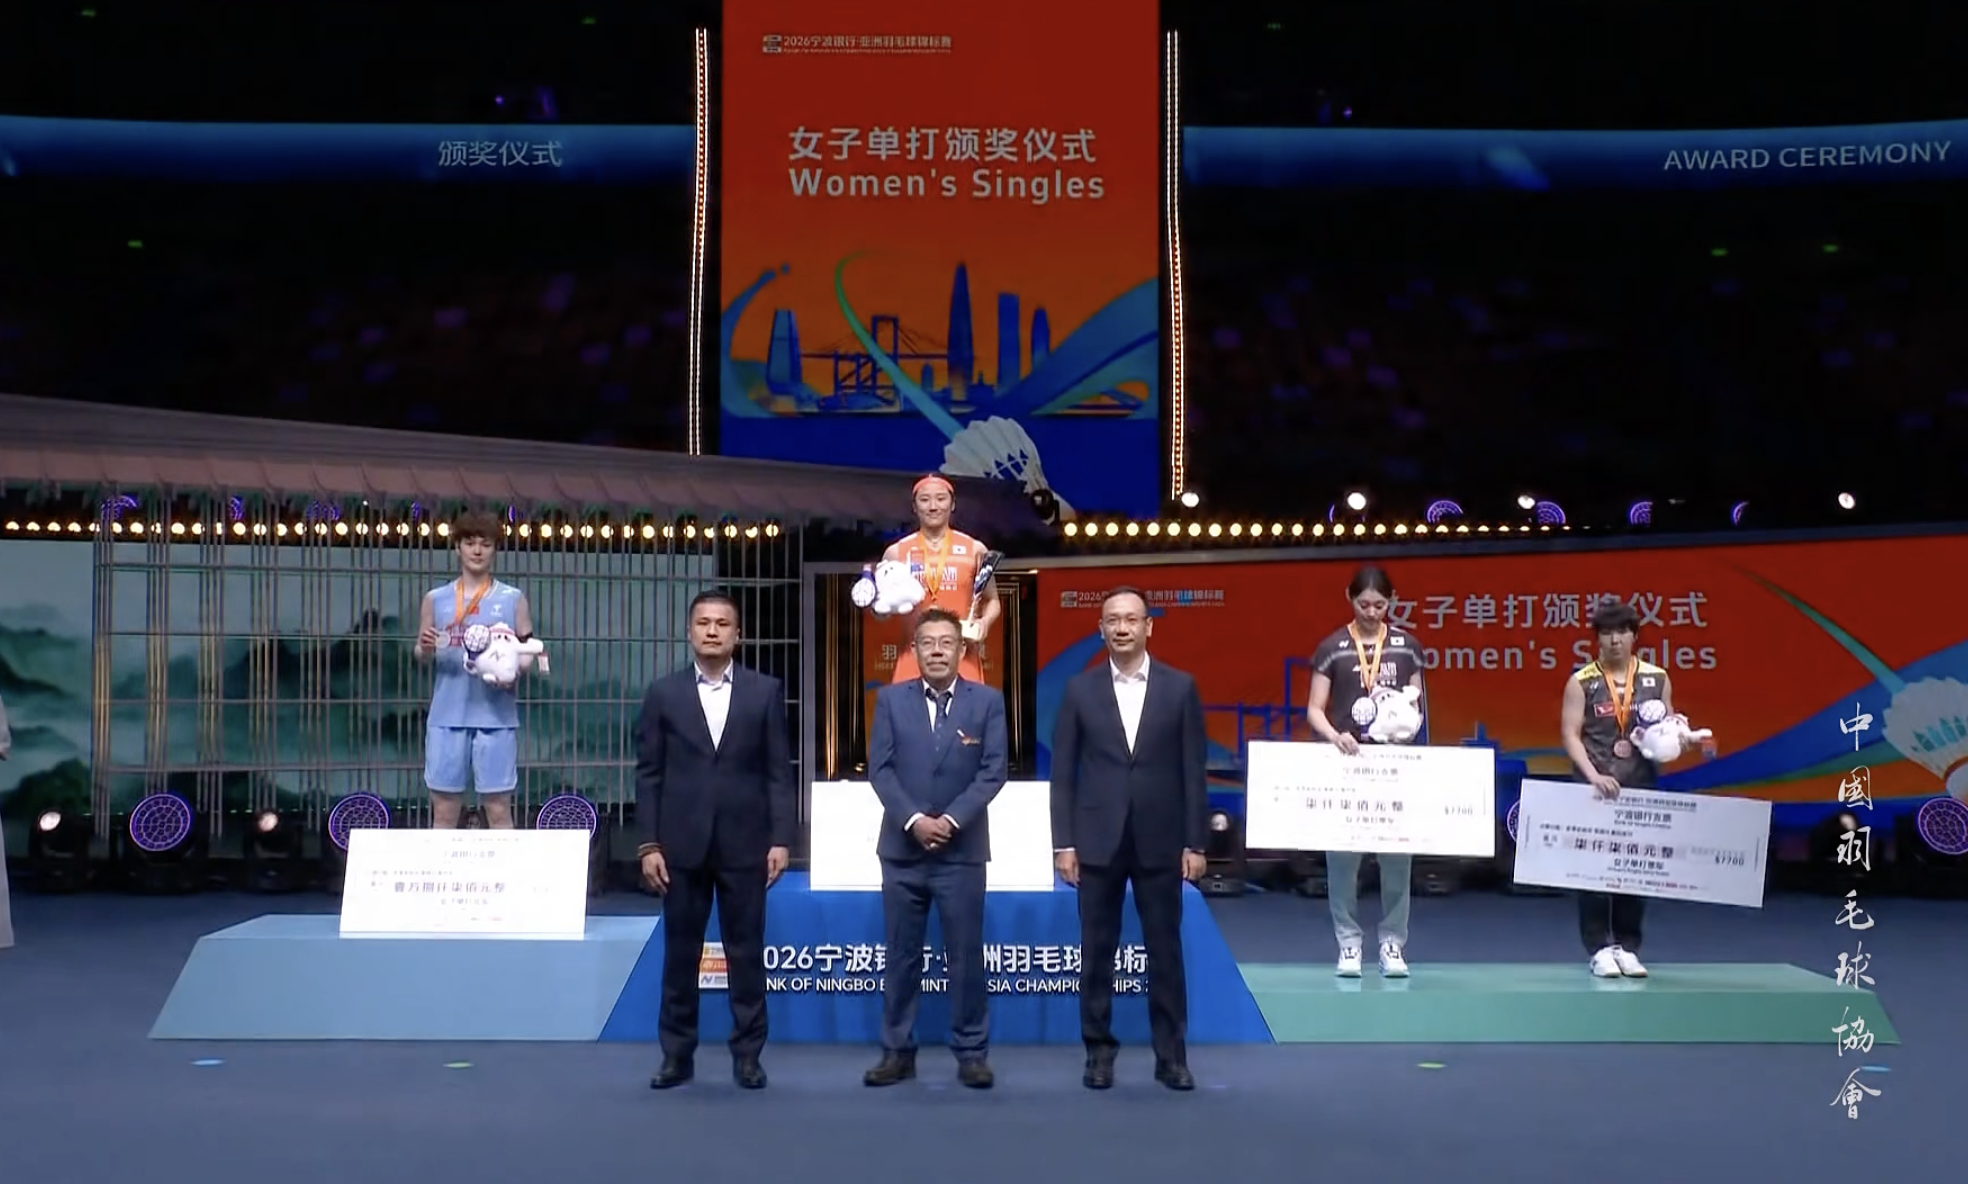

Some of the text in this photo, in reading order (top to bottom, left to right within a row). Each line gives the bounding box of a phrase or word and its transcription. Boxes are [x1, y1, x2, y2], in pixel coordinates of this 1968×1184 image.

[438, 140, 563, 167] 颁奖仪式
[788, 126, 1097, 162] 女子单打颁奖仪式
[1663, 140, 1951, 171] AWARD CEREMONY
[788, 167, 1105, 205] Women's Singles
[1423, 640, 1558, 670] omen's
[1714, 855, 1745, 867] $7700
[766, 977, 787, 992] NK
[790, 977, 813, 992] OF
[816, 977, 876, 992] NINGBO
[987, 978, 1012, 993] SIA
